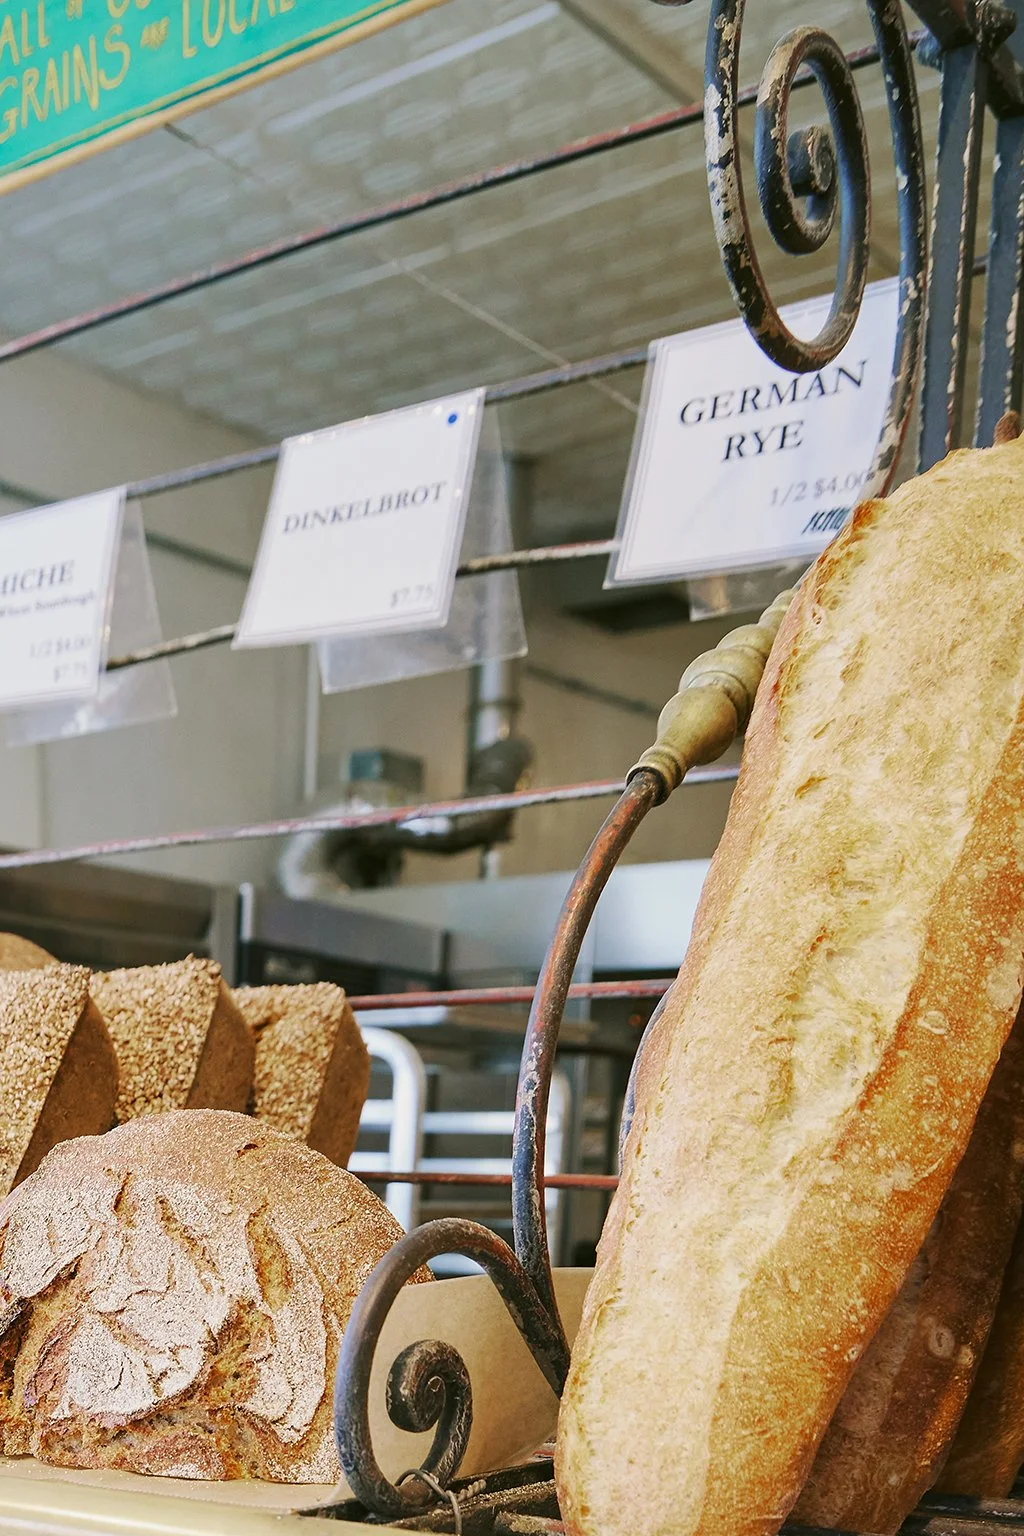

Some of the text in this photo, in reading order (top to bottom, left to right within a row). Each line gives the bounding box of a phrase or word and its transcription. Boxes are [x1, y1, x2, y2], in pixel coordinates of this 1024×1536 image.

[182, 0, 296, 59] LOC
[678, 359, 869, 427] GERMAN
[722, 420, 805, 464] RYE
[282, 480, 447, 534] DINKELBROT
[771, 480, 808, 508] 1/2
